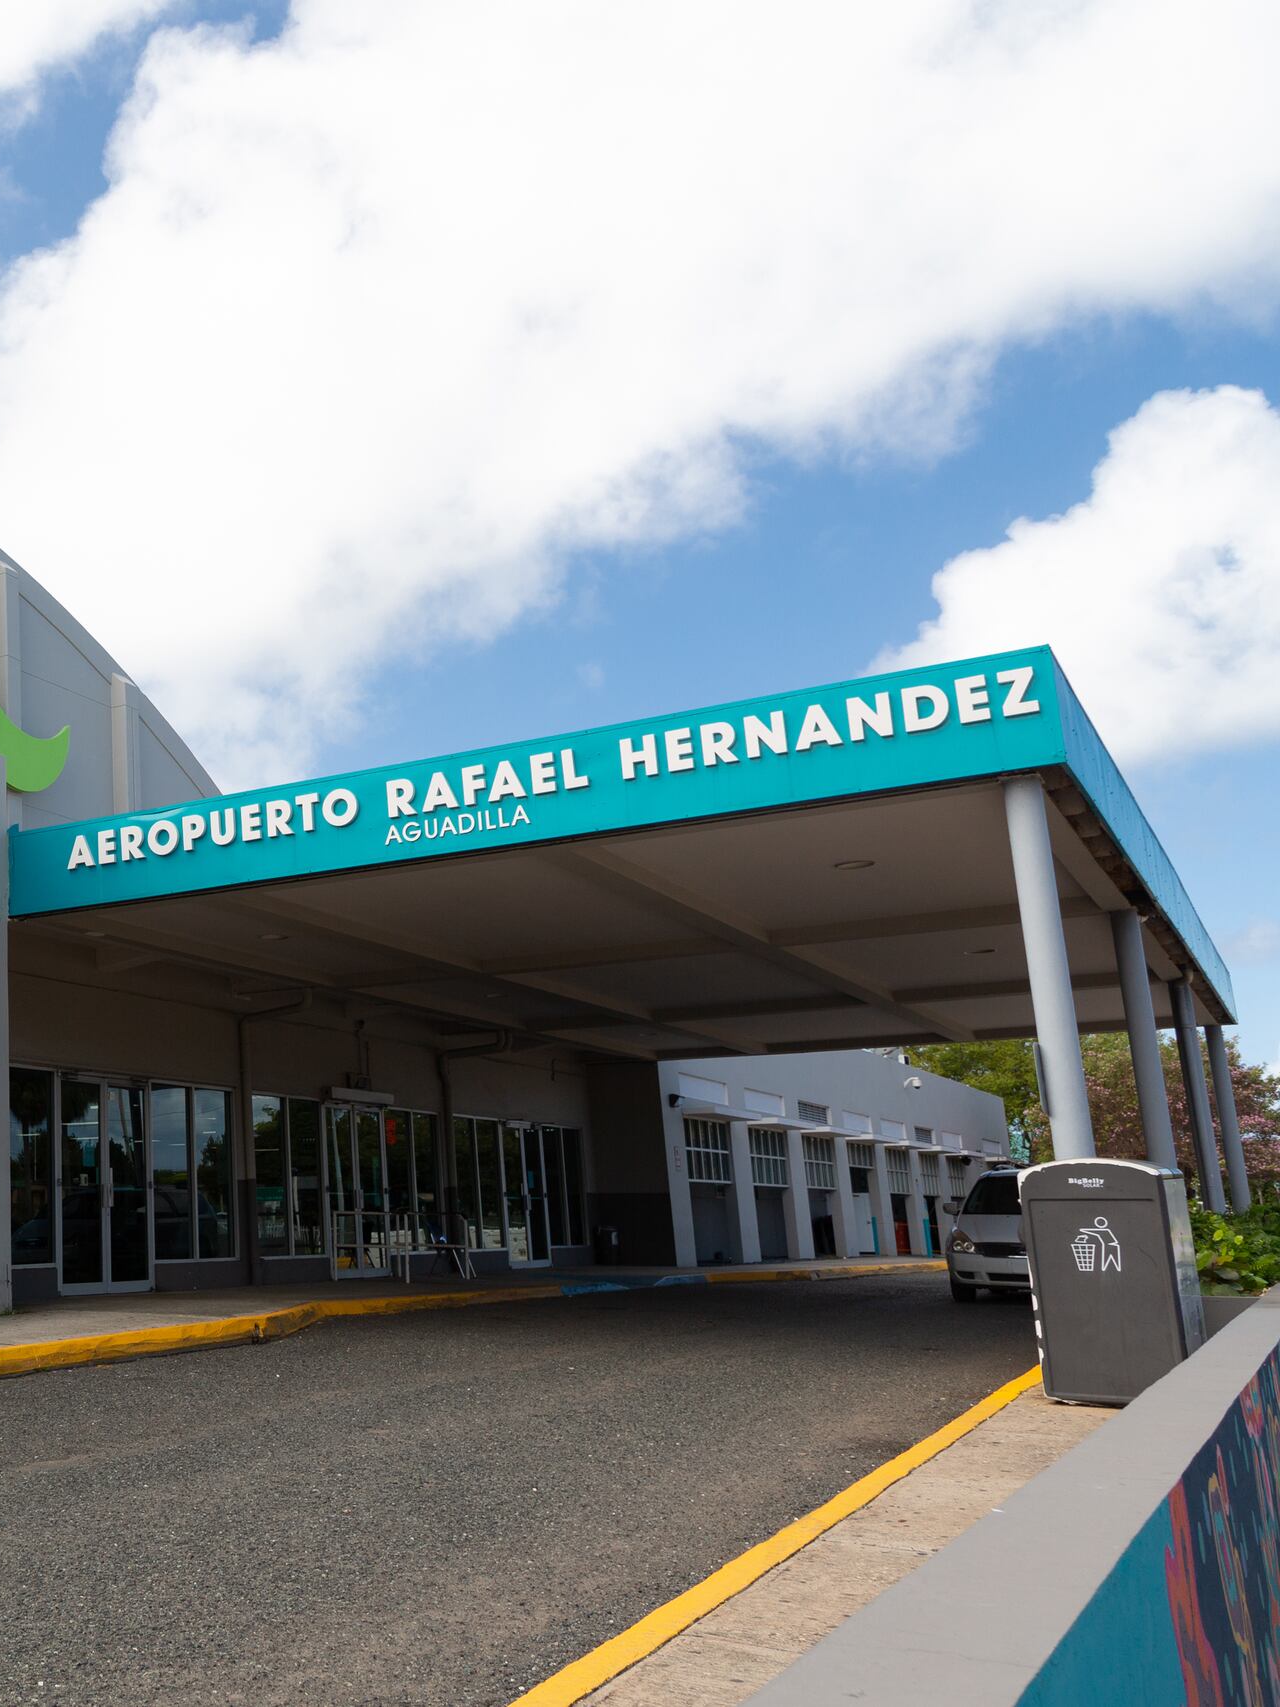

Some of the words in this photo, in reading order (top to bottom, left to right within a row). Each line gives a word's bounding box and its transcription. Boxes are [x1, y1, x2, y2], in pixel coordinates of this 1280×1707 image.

[67, 788, 357, 869] AEROPUERTO
[386, 748, 589, 818] RAFAEL
[619, 666, 1040, 780] HERNANDEZ
[385, 804, 531, 846] AGUADILLA
